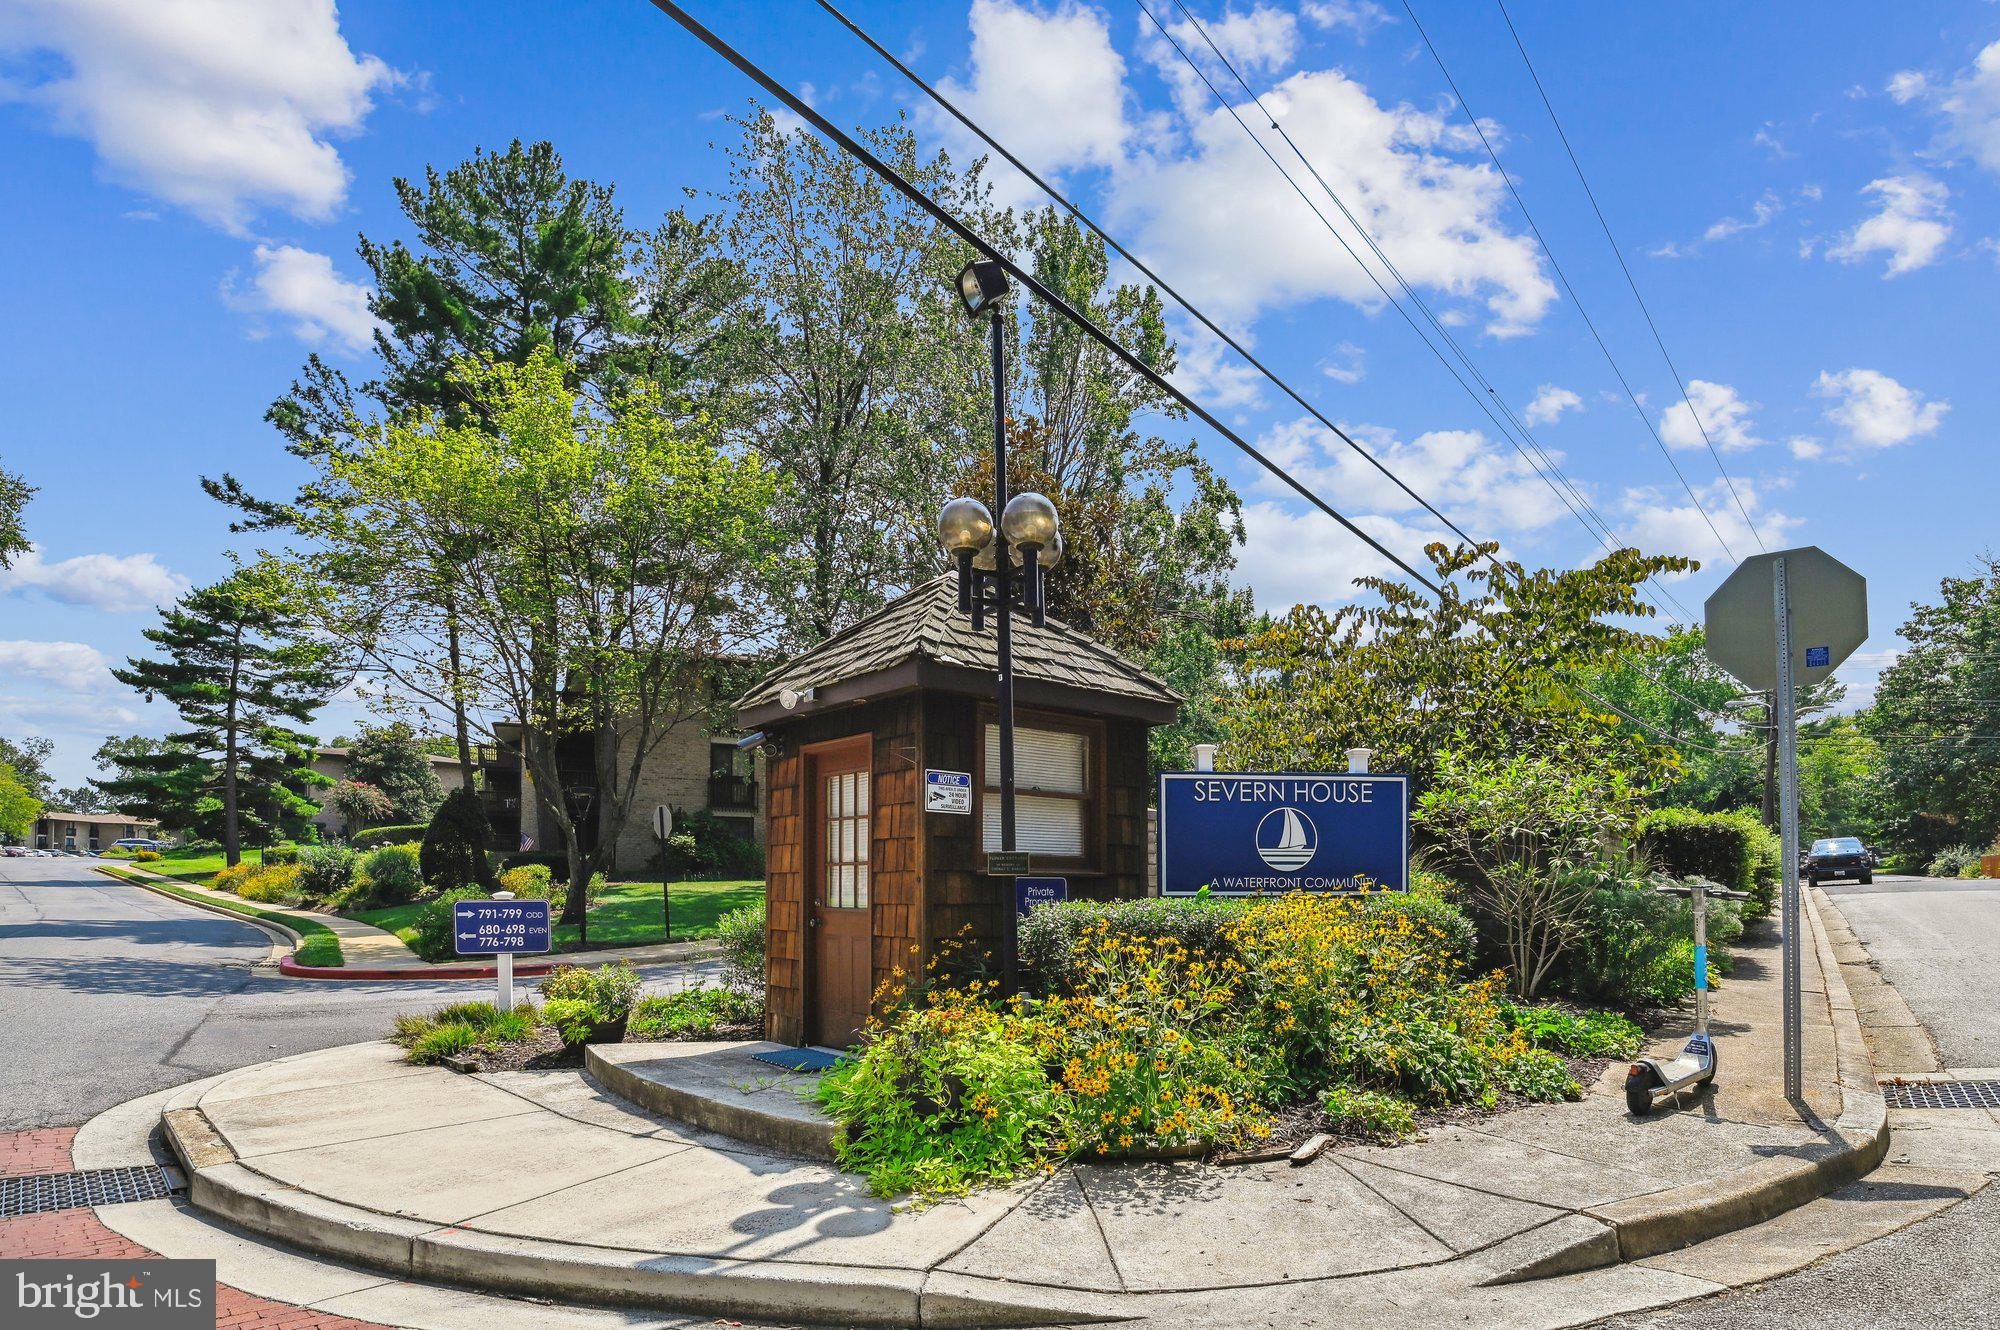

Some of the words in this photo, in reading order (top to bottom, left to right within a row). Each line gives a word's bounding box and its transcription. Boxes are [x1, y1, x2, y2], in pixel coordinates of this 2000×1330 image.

[937, 774, 960, 785] NOTICE
[1194, 780, 1285, 802] SEVERN
[1294, 782, 1373, 803] HOUSE
[1211, 878, 1220, 888] A
[1223, 877, 1301, 888] WATERFRONT
[1304, 877, 1378, 888] COMMUNITY
[1027, 887, 1055, 896] Private
[1024, 897, 1058, 907] Propert
[478, 909, 522, 919] 791-799
[479, 924, 526, 935] 680-698
[479, 937, 524, 947] 776-798
